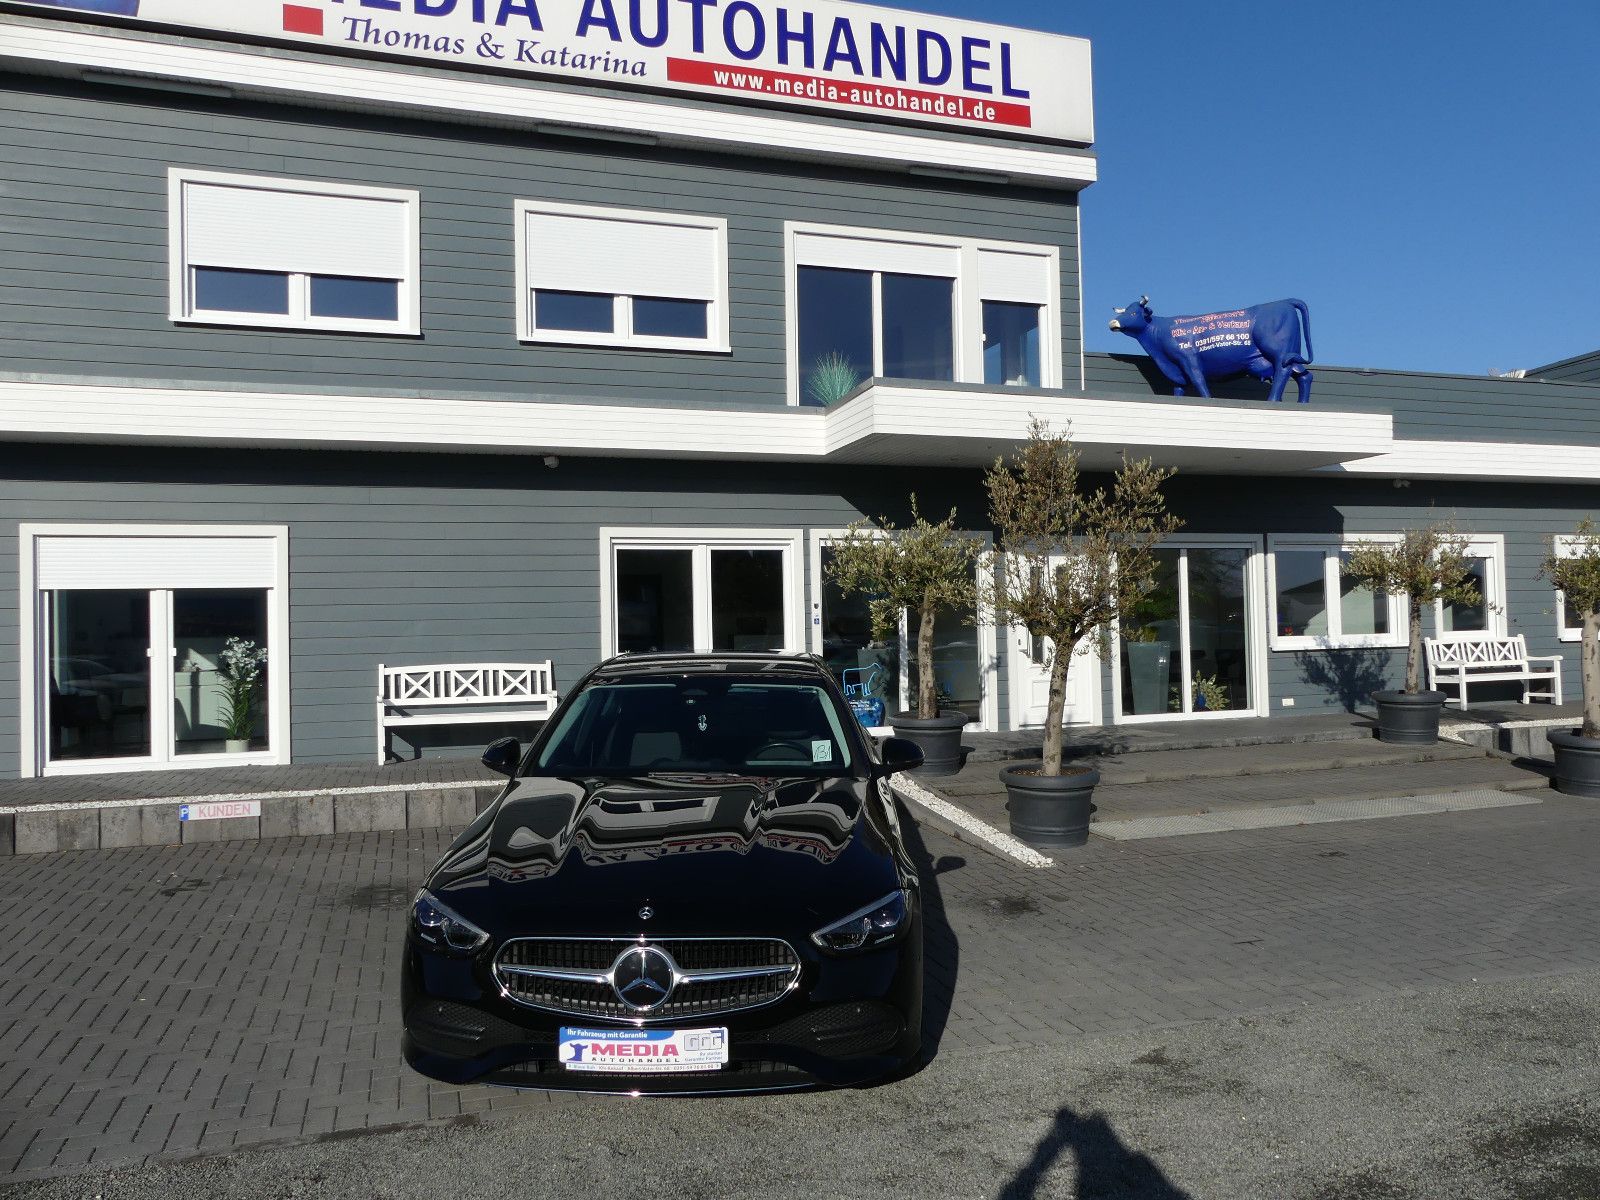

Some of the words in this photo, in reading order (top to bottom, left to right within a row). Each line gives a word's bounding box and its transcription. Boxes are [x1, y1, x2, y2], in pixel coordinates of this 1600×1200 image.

[342, 16, 465, 55] Thomas
[476, 32, 505, 60] &
[514, 39, 648, 77] Katarina
[576, 0, 1031, 99] AUTOHANDEL
[713, 68, 996, 121] www.media-autohandel.de
[180, 807, 189, 818] P
[198, 803, 251, 818] KUNDEN
[577, 1030, 606, 1039] Fahrzeug
[591, 1043, 680, 1057] MEDIA
